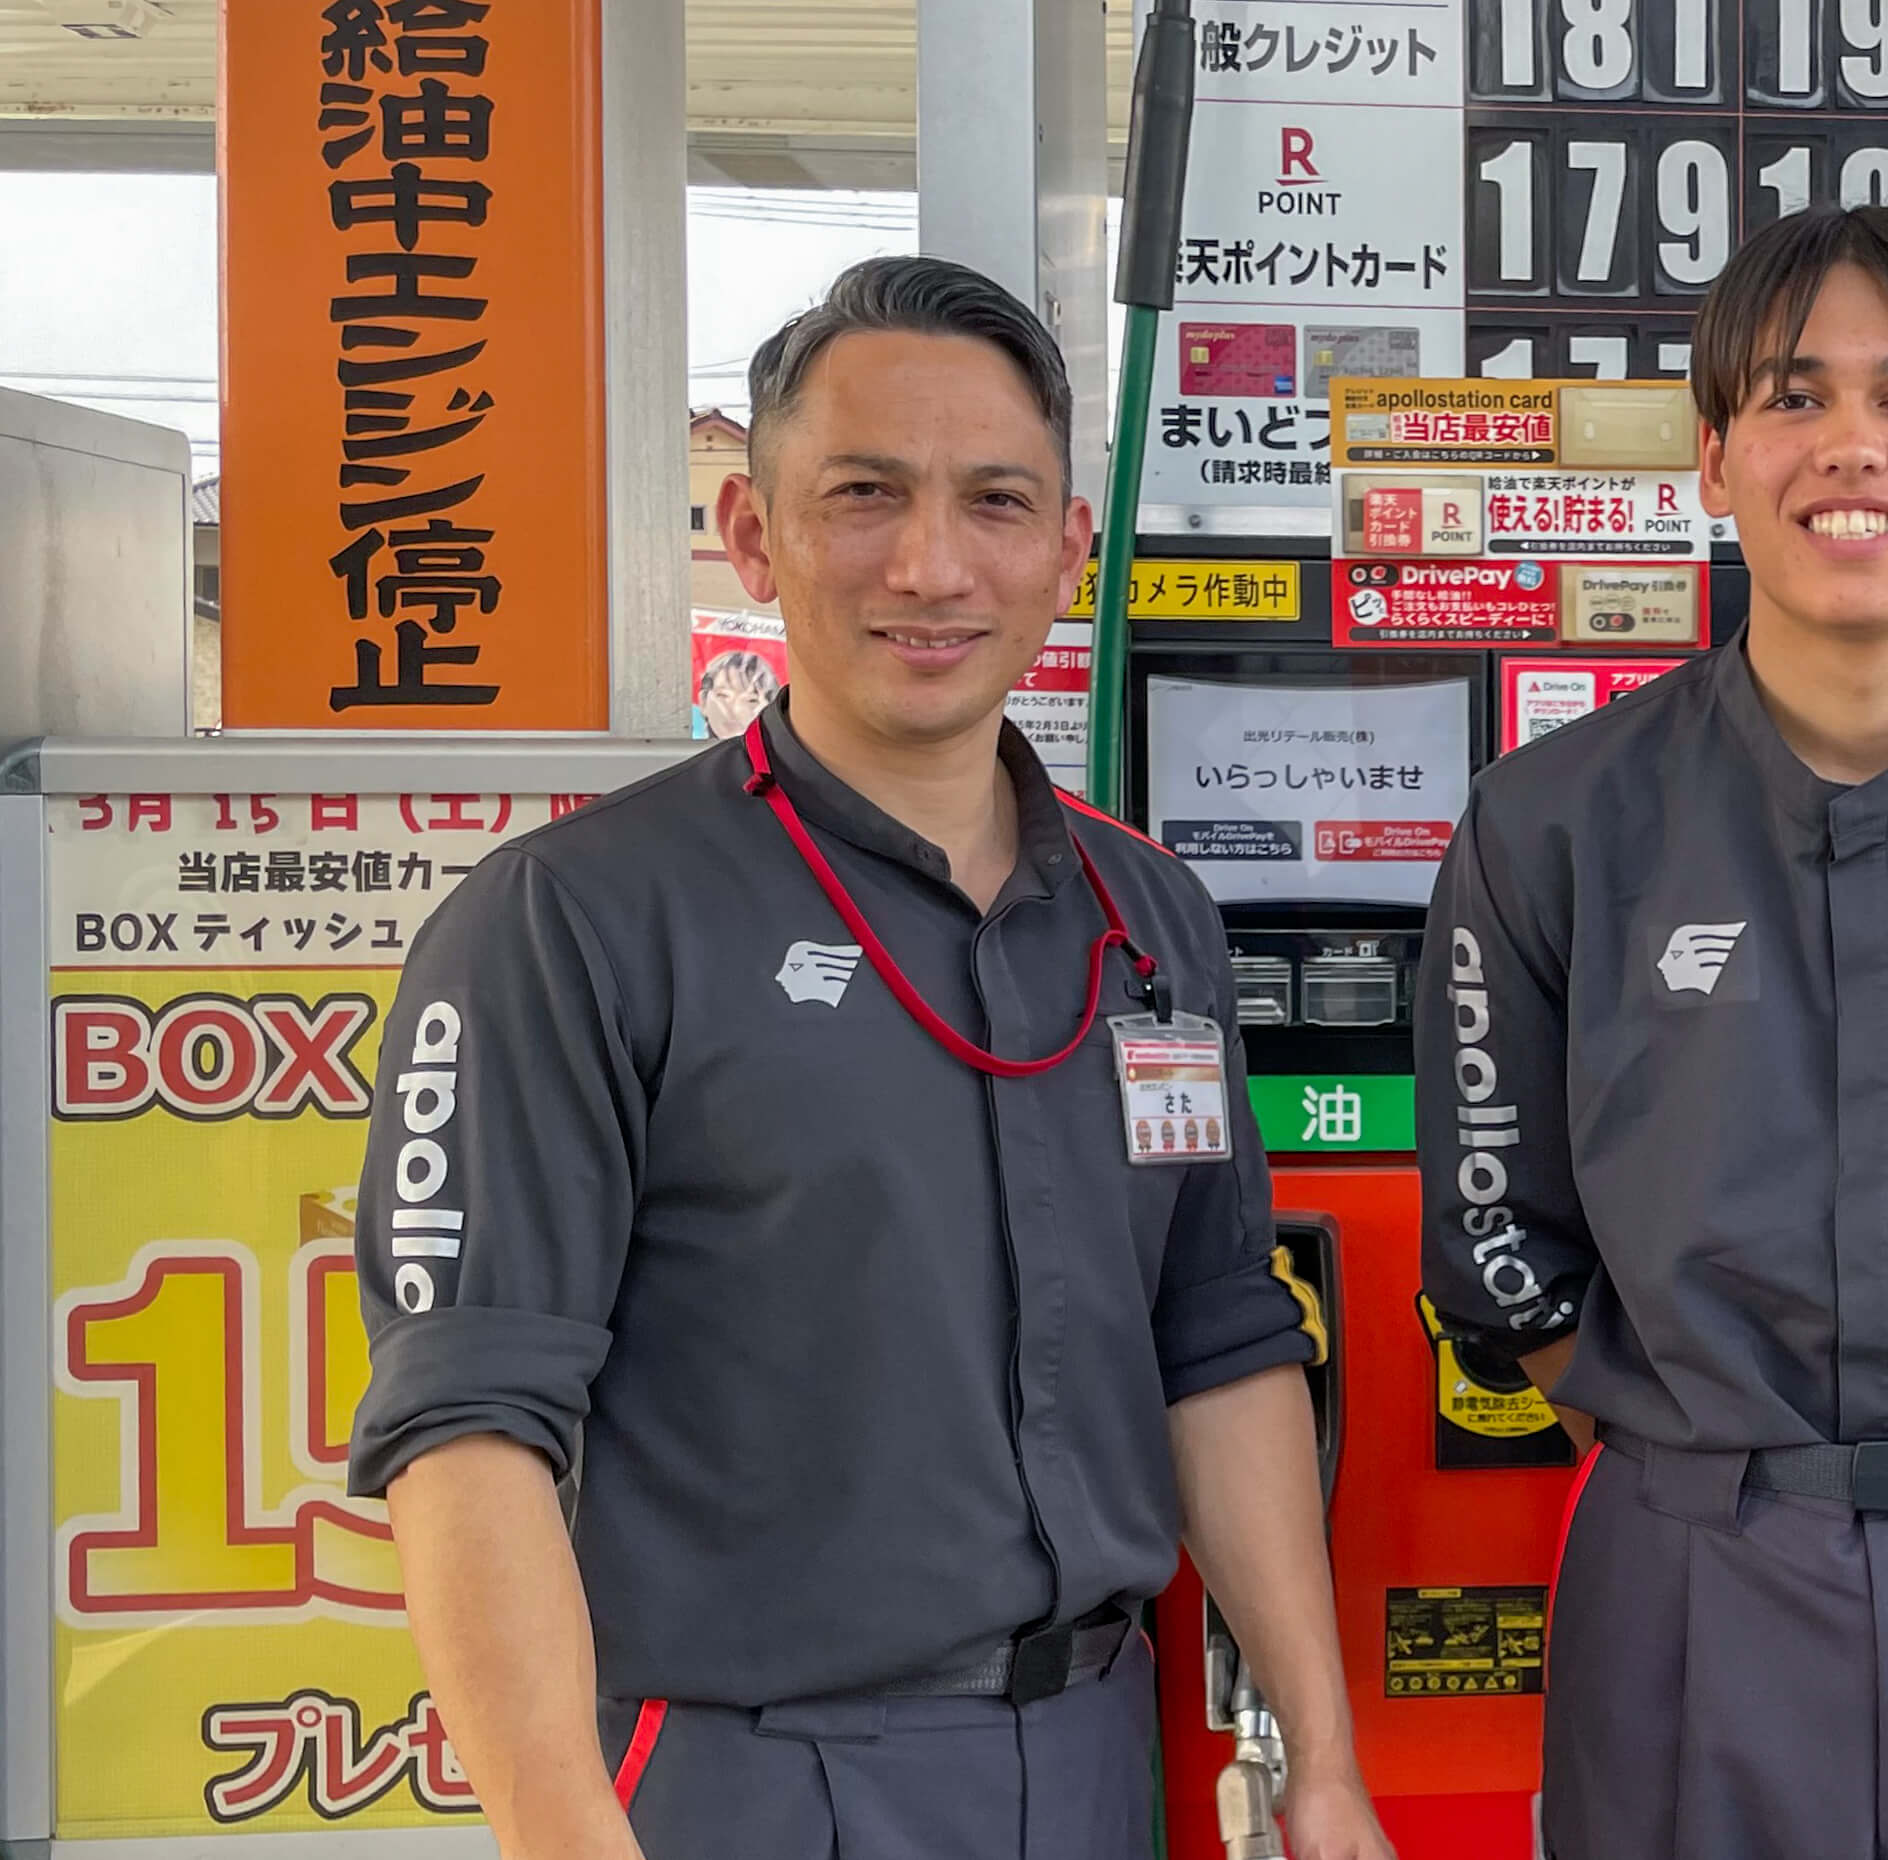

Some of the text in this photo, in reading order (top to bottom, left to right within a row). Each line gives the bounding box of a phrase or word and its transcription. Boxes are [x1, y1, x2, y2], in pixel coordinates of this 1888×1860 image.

[1258, 191, 1342, 216] POINT
[1480, 140, 1730, 284] 179
[1176, 239, 1447, 289] 天ポイントカード
[318, 0, 502, 713] 給油中エンジン停止
[1376, 389, 1504, 411] apollostation
[1509, 391, 1553, 409] card
[1402, 412, 1553, 443] 当店最安値
[1488, 476, 1635, 491] 給油で楽天ポイントが
[1368, 507, 1417, 519] ポイント
[1645, 519, 1691, 533] POINT
[1369, 520, 1410, 533] カード
[1431, 531, 1473, 542] POINT
[1073, 572, 1288, 608] メラ作動中
[1401, 564, 1513, 590] DrivePay
[1582, 579, 1649, 594] DrivePay
[1195, 763, 1424, 791] いらっしゃいませ
[52, 994, 376, 1121] BOX
[1301, 1084, 1361, 1142] 油
